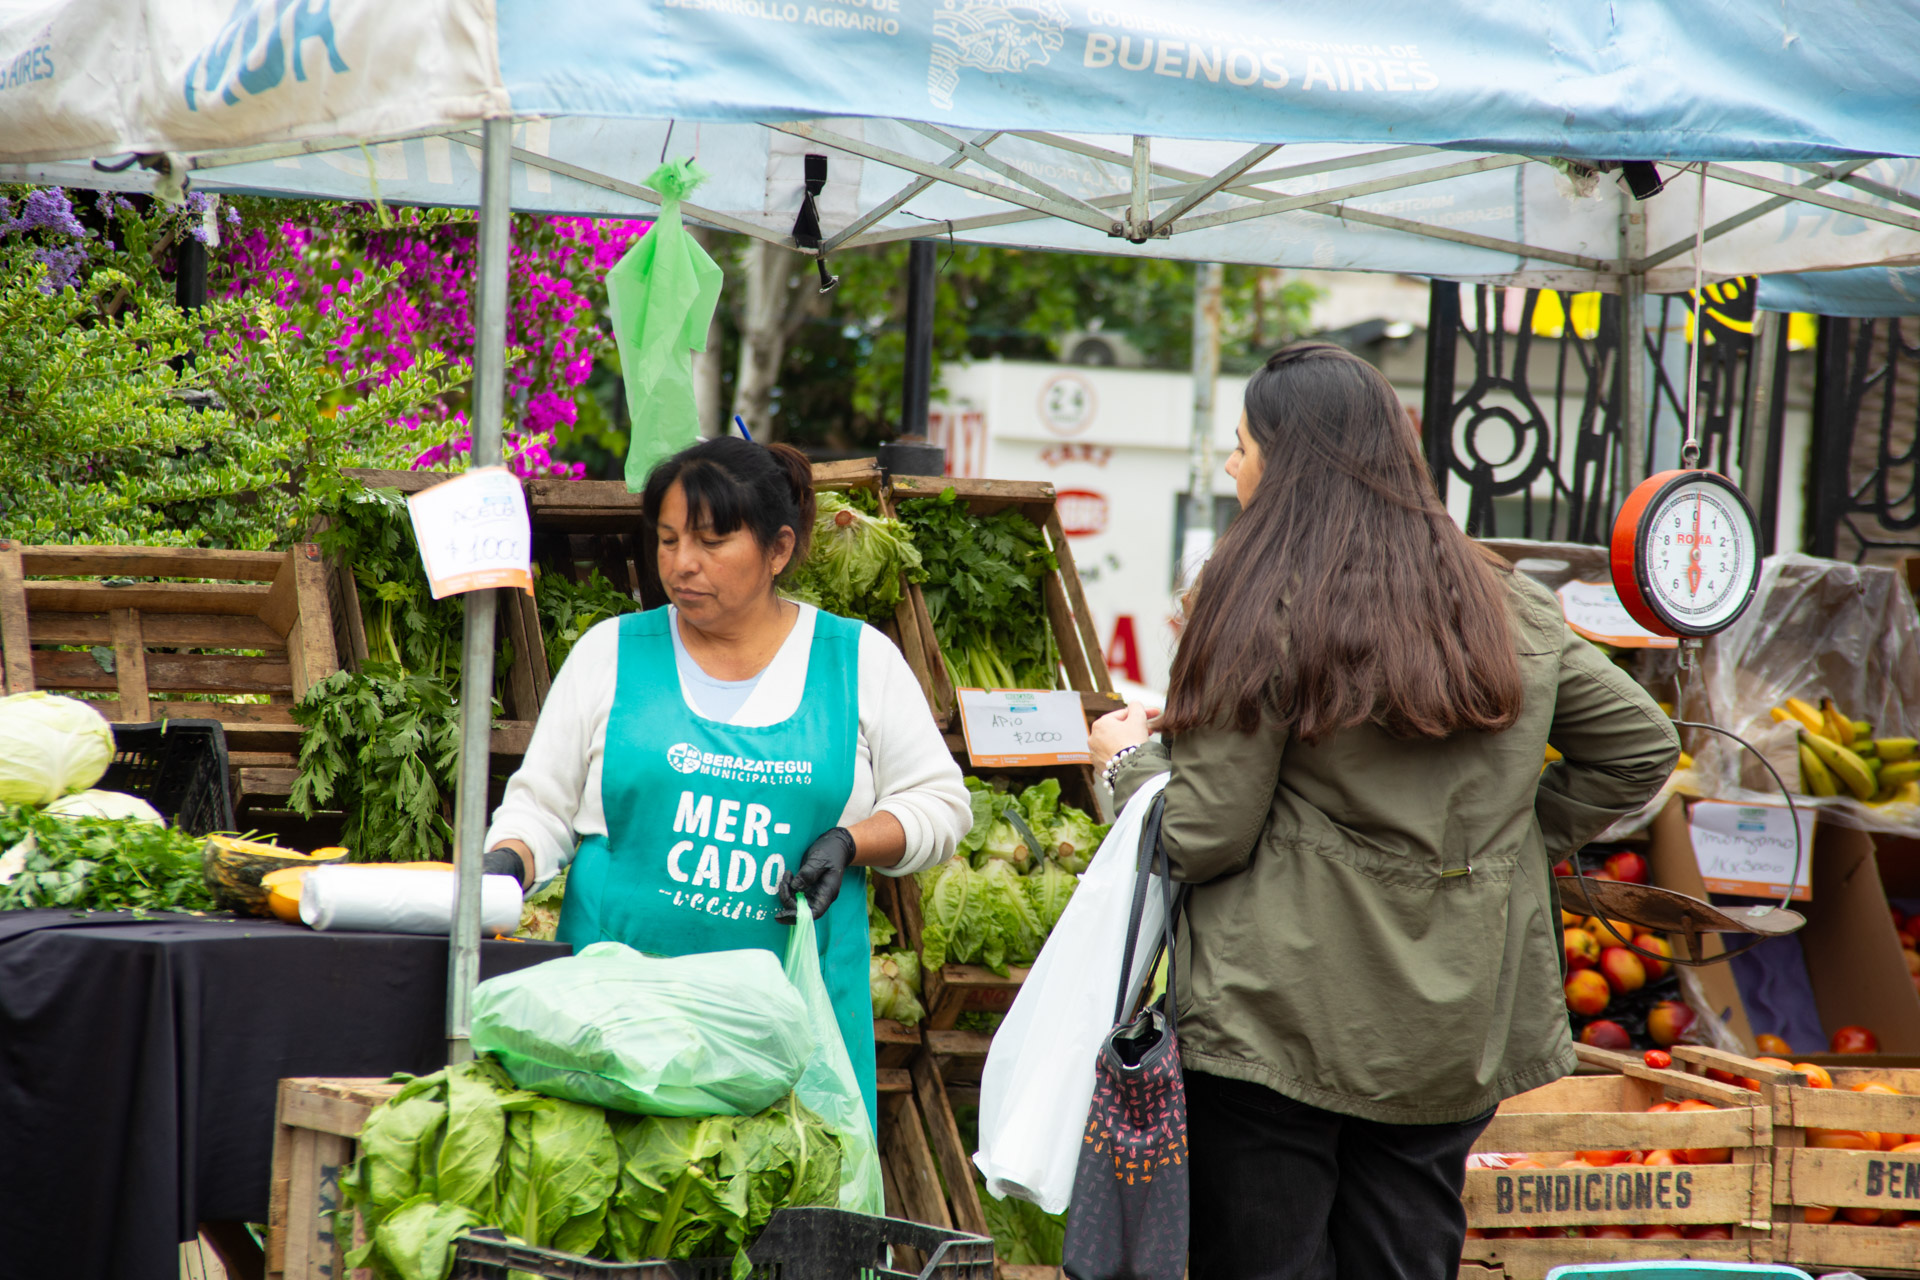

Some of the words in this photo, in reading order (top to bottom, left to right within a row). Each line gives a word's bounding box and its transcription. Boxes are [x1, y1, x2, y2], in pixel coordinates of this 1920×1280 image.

[804, 6, 899, 36] AGRARIO
[1391, 44, 1423, 59] DE
[8, 44, 55, 90] AIRES
[1083, 33, 1290, 90] BUENOS
[1302, 55, 1440, 92] AIRES
[1674, 517, 1681, 529] 9
[1711, 519, 1717, 530] 1
[1664, 534, 1670, 546] 8
[1719, 537, 1726, 548] 2
[1663, 559, 1669, 571] 7
[1719, 562, 1726, 573] 3
[1672, 578, 1679, 590] 6
[1708, 579, 1714, 590] 4
[1013, 731, 1062, 746] $2000
[702, 752, 812, 775] BERAZATEGUI
[700, 764, 812, 785] MUNICIPALIDAD
[672, 790, 791, 847] MER-
[666, 840, 786, 896] CADO
[1866, 1160, 1920, 1199] BEN
[1496, 1171, 1693, 1214] BENDICIONES
